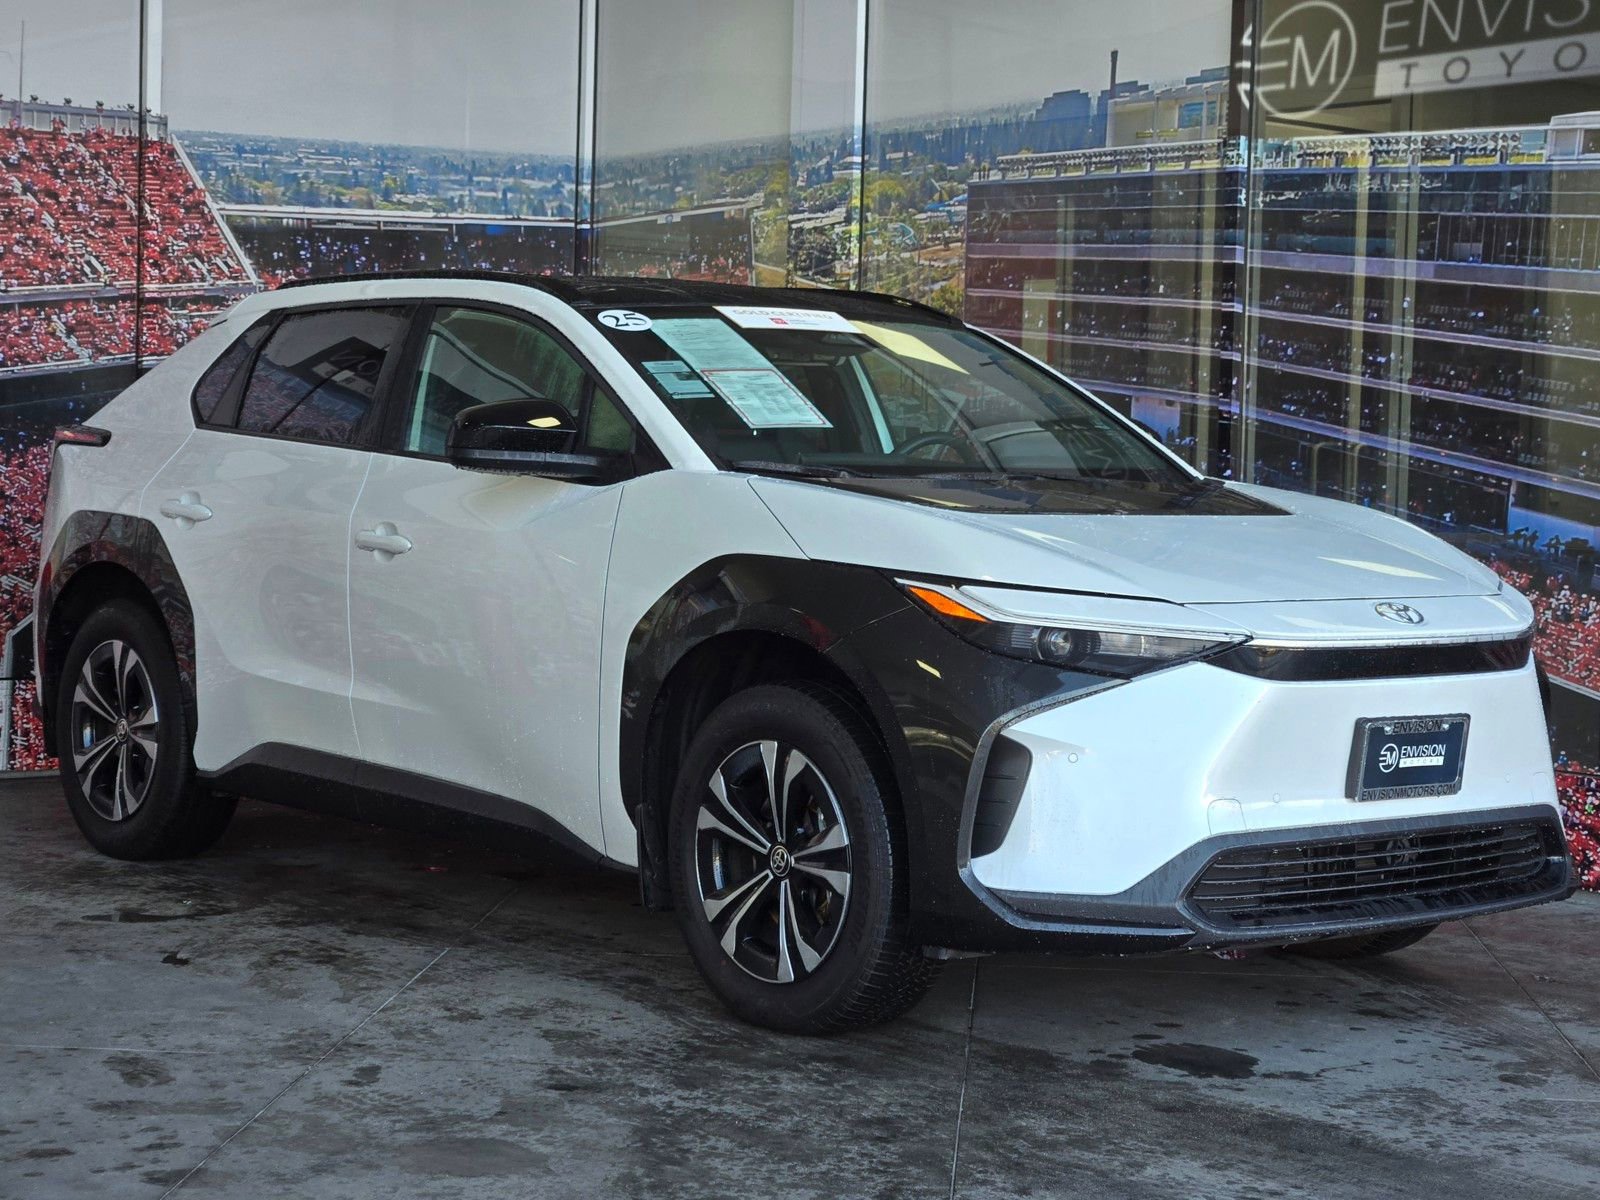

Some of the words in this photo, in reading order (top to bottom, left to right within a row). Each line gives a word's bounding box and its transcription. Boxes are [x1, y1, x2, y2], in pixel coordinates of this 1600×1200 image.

[604, 309, 647, 327] 25
[1392, 720, 1442, 734] ENVISION
[1400, 743, 1447, 757] ENVISION
[1361, 783, 1456, 801] ENVISIONMOTORS.COM
